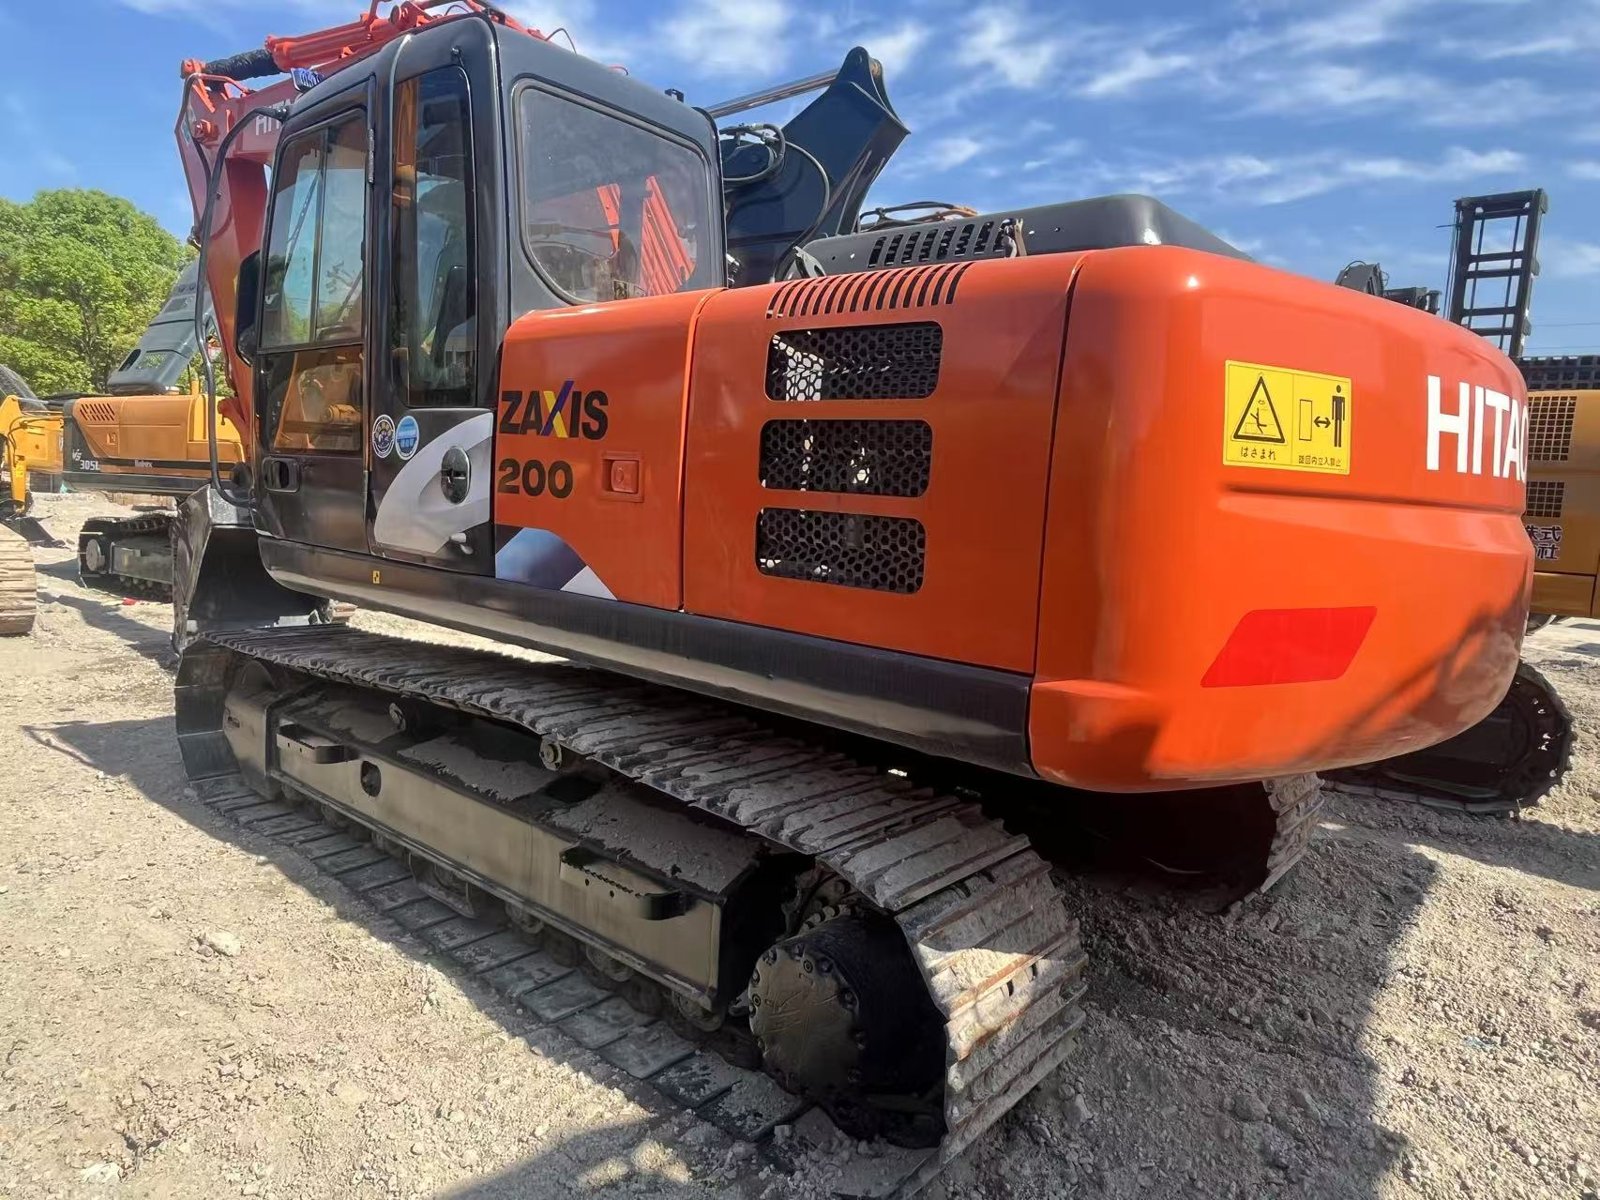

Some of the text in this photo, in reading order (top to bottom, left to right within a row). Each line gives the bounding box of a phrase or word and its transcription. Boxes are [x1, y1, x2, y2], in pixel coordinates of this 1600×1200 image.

[500, 379, 609, 440] ZAXIS
[1240, 446, 1277, 461] はさまれ
[498, 458, 573, 498] 200
